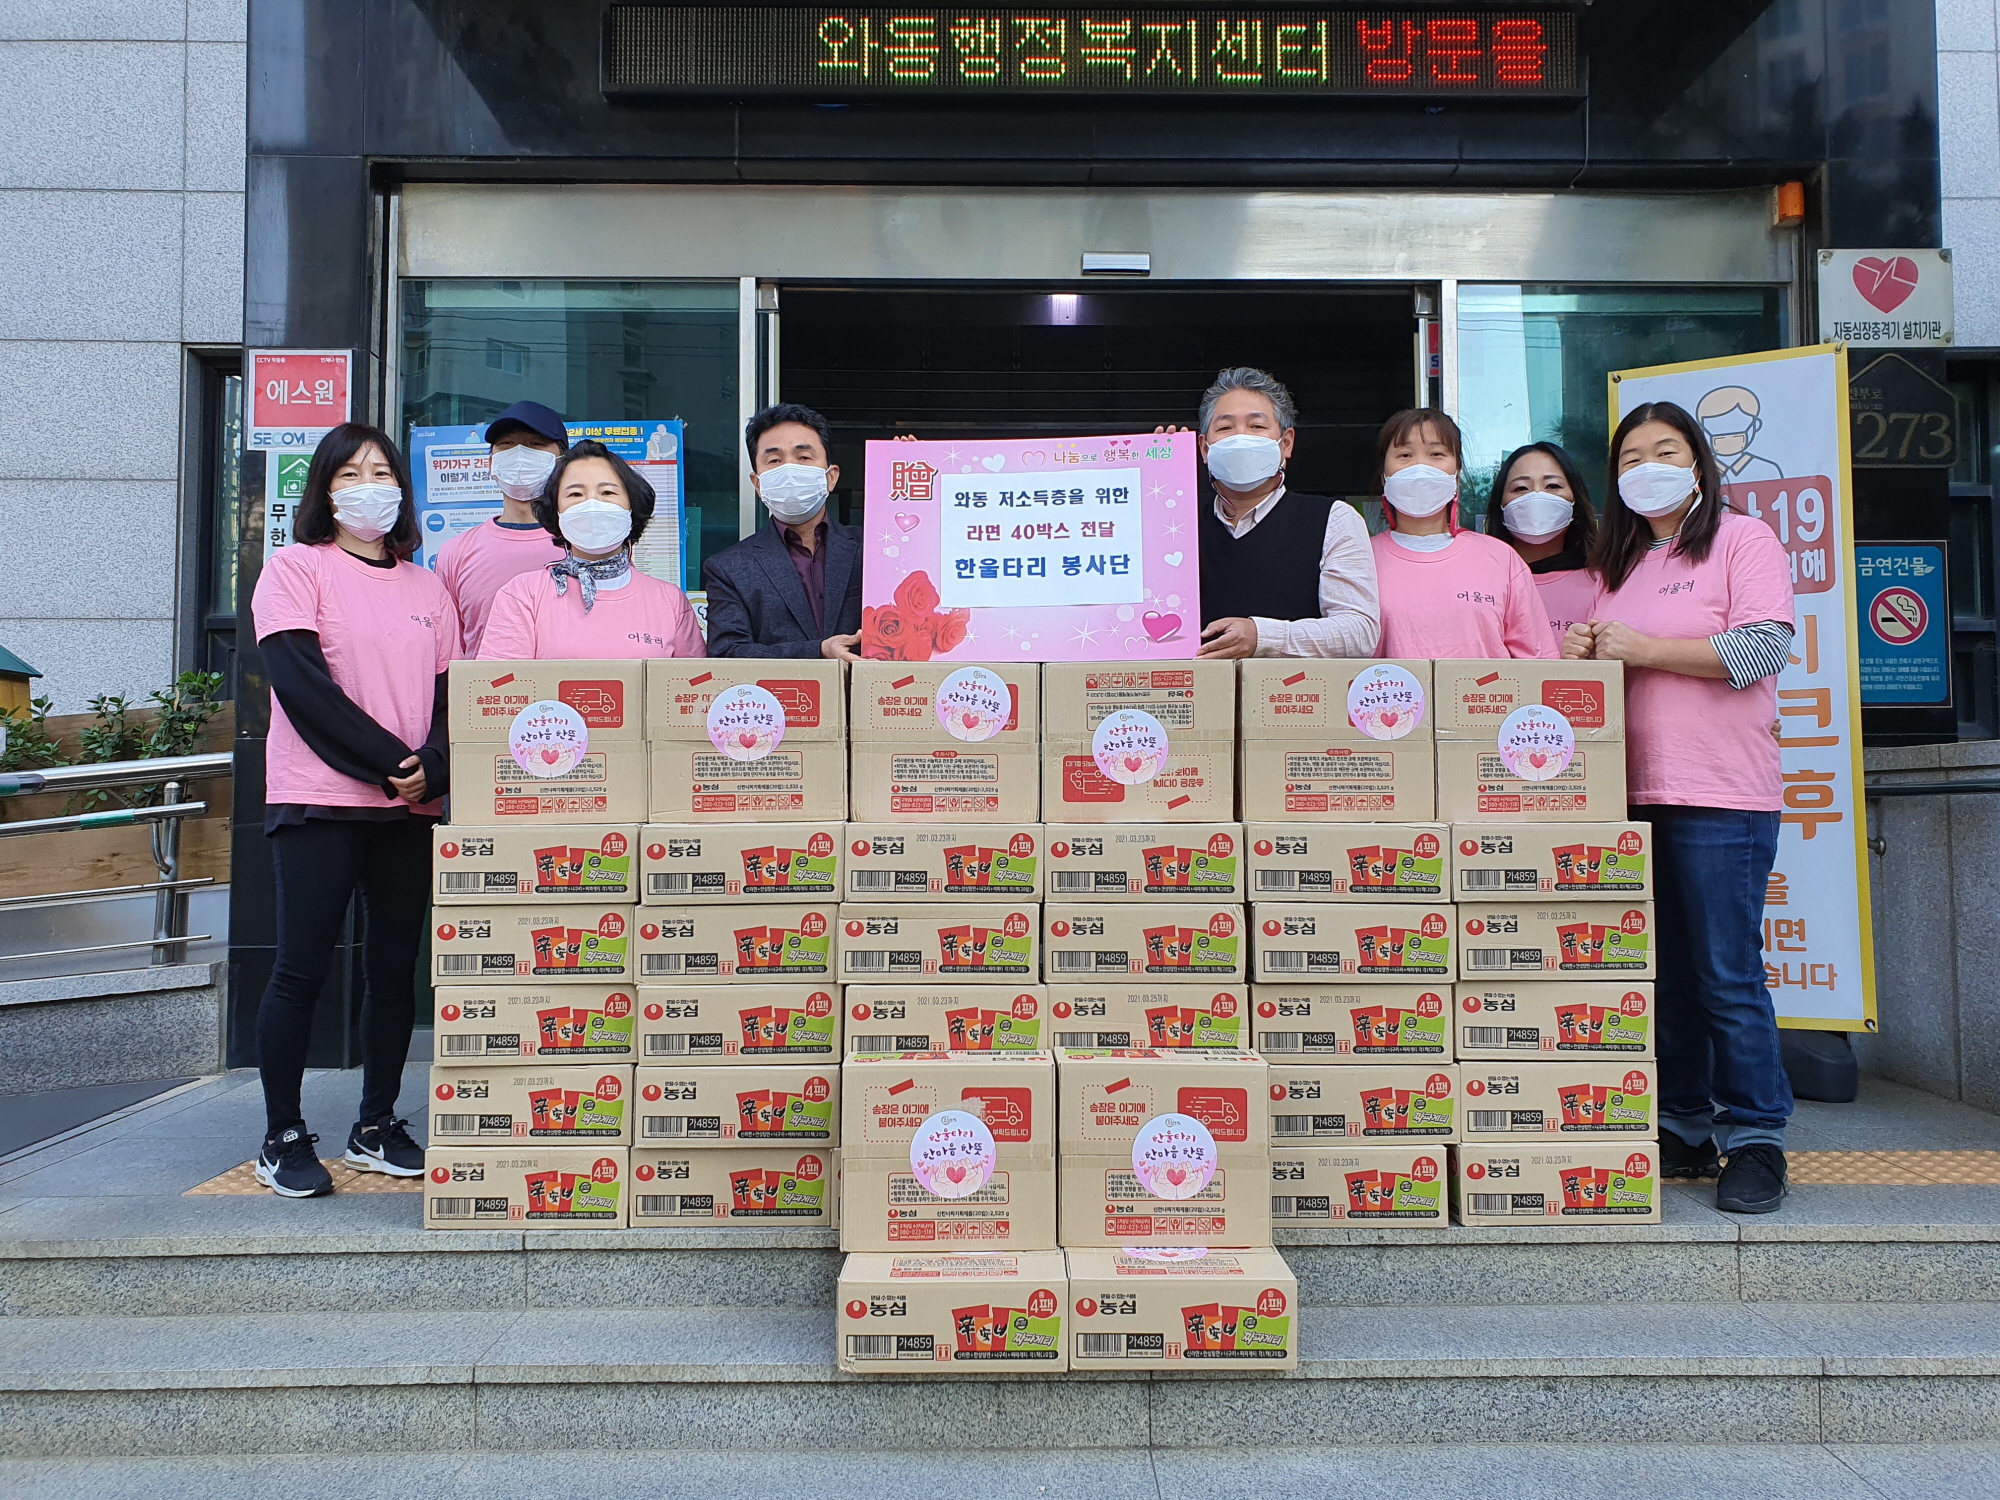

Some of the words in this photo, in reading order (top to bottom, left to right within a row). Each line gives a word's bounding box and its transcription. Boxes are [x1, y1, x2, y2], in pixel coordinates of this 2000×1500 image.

[818, 16, 1329, 79] 와동행정복지센터
[1357, 19, 1548, 81] 방문을
[1833, 321, 1900, 340] 자동심장충격기
[1903, 321, 1941, 340] 설치기관
[266, 379, 334, 405] 에스원
[253, 432, 305, 445] SECOM
[585, 427, 602, 437] 이상
[1855, 412, 1952, 459] 273
[1054, 450, 1098, 464] 나눔으로
[1103, 448, 1139, 462] 행복한
[1144, 445, 1172, 460] 세상
[432, 458, 471, 470] 위기가구
[440, 471, 469, 483] 이렇게
[954, 491, 988, 508] 와동
[999, 488, 1085, 508] 저소득층을
[1095, 486, 1129, 505] 위한
[967, 524, 1001, 541] 라면
[1010, 522, 1070, 540] 40박스
[1080, 521, 1115, 538] 전달
[954, 556, 1046, 579] 한울타리
[1061, 553, 1131, 577] 봉사단
[1858, 557, 1928, 577] 금연건물
[958, 680, 997, 697] 한울타리
[1363, 678, 1404, 692] 한울타리
[877, 695, 902, 705] 송장은
[904, 695, 928, 705] 여기에
[948, 690, 978, 704] 한마음
[981, 698, 1000, 713] 한뜻
[1268, 694, 1292, 704] 송장은
[1295, 694, 1320, 704] 여기에
[1359, 693, 1390, 708] 한마음
[1392, 690, 1413, 703] 한뜻
[1462, 693, 1486, 704] 송장은
[1489, 693, 1513, 704] 여기에
[725, 699, 766, 713] 한울타리
[527, 714, 569, 729] 한울타리
[718, 712, 749, 727] 한마음
[753, 712, 774, 725] 한뜻
[1515, 720, 1556, 732] 한울타리
[521, 729, 551, 743] 한마음
[555, 728, 577, 741] 한뜻
[1108, 723, 1149, 737] 한울타리
[1103, 737, 1133, 752] 한마음
[1137, 736, 1157, 749] 한뜻
[1509, 732, 1540, 747] 한마음
[1544, 732, 1564, 746] 한뜻
[461, 843, 494, 856] 농심
[602, 840, 624, 853] 4팩
[668, 844, 701, 857] 농심
[809, 841, 831, 853] 4팩
[872, 842, 904, 855] 농심
[1011, 841, 1031, 854] 4팩
[1071, 843, 1103, 856] 농심
[1209, 841, 1231, 854] 4팩
[1274, 842, 1307, 855] 농심
[1416, 842, 1437, 854] 4팩
[1480, 841, 1513, 853] 농심
[1619, 839, 1640, 852] 4팩
[458, 925, 491, 938] 농심
[866, 922, 898, 934] 농심
[1283, 923, 1316, 935] 농심
[1486, 920, 1518, 933] 농심
[665, 1004, 698, 1018] 농심
[1073, 1003, 1105, 1016] 농심
[1483, 998, 1515, 1011] 농심
[1622, 999, 1643, 1013] 4팩
[456, 1085, 489, 1098] 농심
[1288, 1085, 1320, 1099] 농심
[1089, 1102, 1116, 1113] 송장은
[1119, 1102, 1146, 1113] 여기에
[929, 1127, 974, 1142] 한울타리
[1152, 1130, 1196, 1144] 한울타리
[923, 1142, 956, 1160] 한마음
[961, 1142, 983, 1155] 한뜻
[1145, 1145, 1178, 1160] 한마음
[1183, 1147, 1204, 1160] 한뜻
[657, 1166, 690, 1179] 농심
[1487, 1164, 1520, 1178] 농심
[1116, 1204, 1134, 1213] 농심
[870, 1301, 906, 1316] 농심
[1030, 1298, 1055, 1314] 4팩
[1099, 1299, 1136, 1315] 농심
[1258, 1297, 1283, 1313] 4팩
